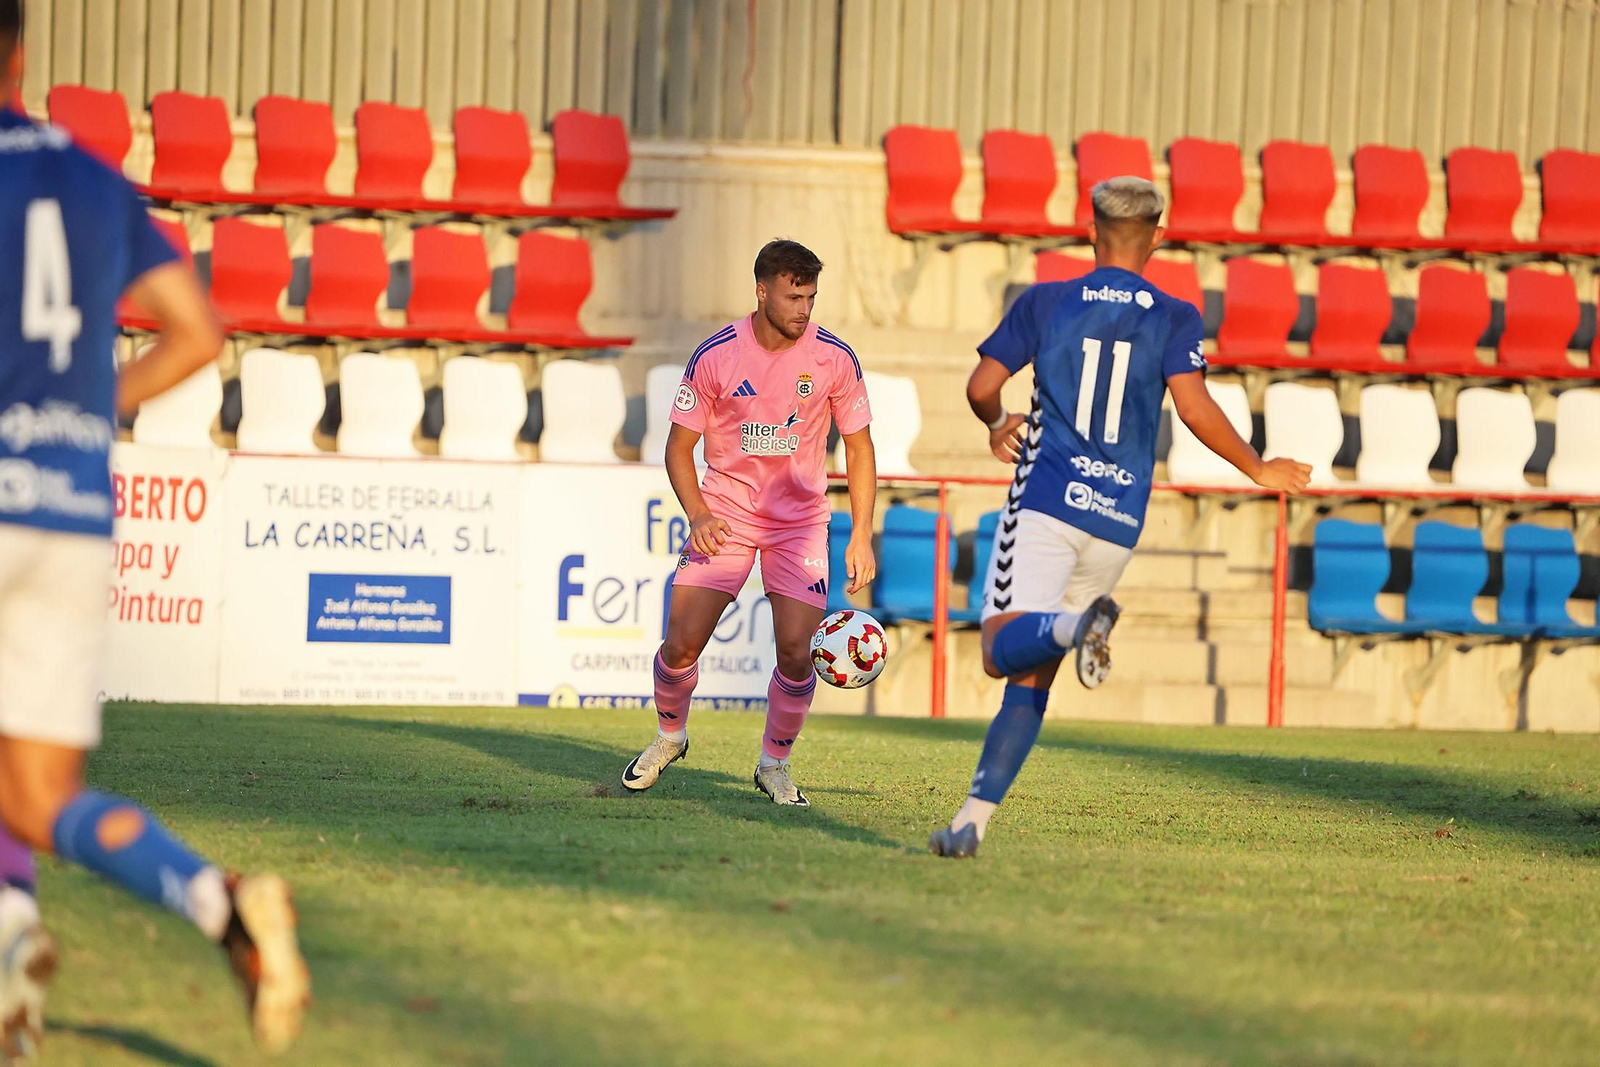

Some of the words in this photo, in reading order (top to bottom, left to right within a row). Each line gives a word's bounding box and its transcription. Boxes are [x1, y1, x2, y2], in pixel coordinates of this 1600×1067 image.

[22, 199, 82, 374] 4
[1075, 337, 1132, 444] 11
[741, 423, 779, 437] alter
[112, 472, 207, 522] BERTO
[263, 484, 344, 509] TALLER
[353, 486, 381, 510] DE
[387, 486, 494, 513] FERRALLA
[245, 520, 279, 548] LA
[109, 540, 153, 577] apa
[161, 545, 180, 580] y
[106, 584, 203, 625] Pintura
[571, 654, 651, 673] CARPINTE
[699, 654, 762, 675] ETÁLICA
